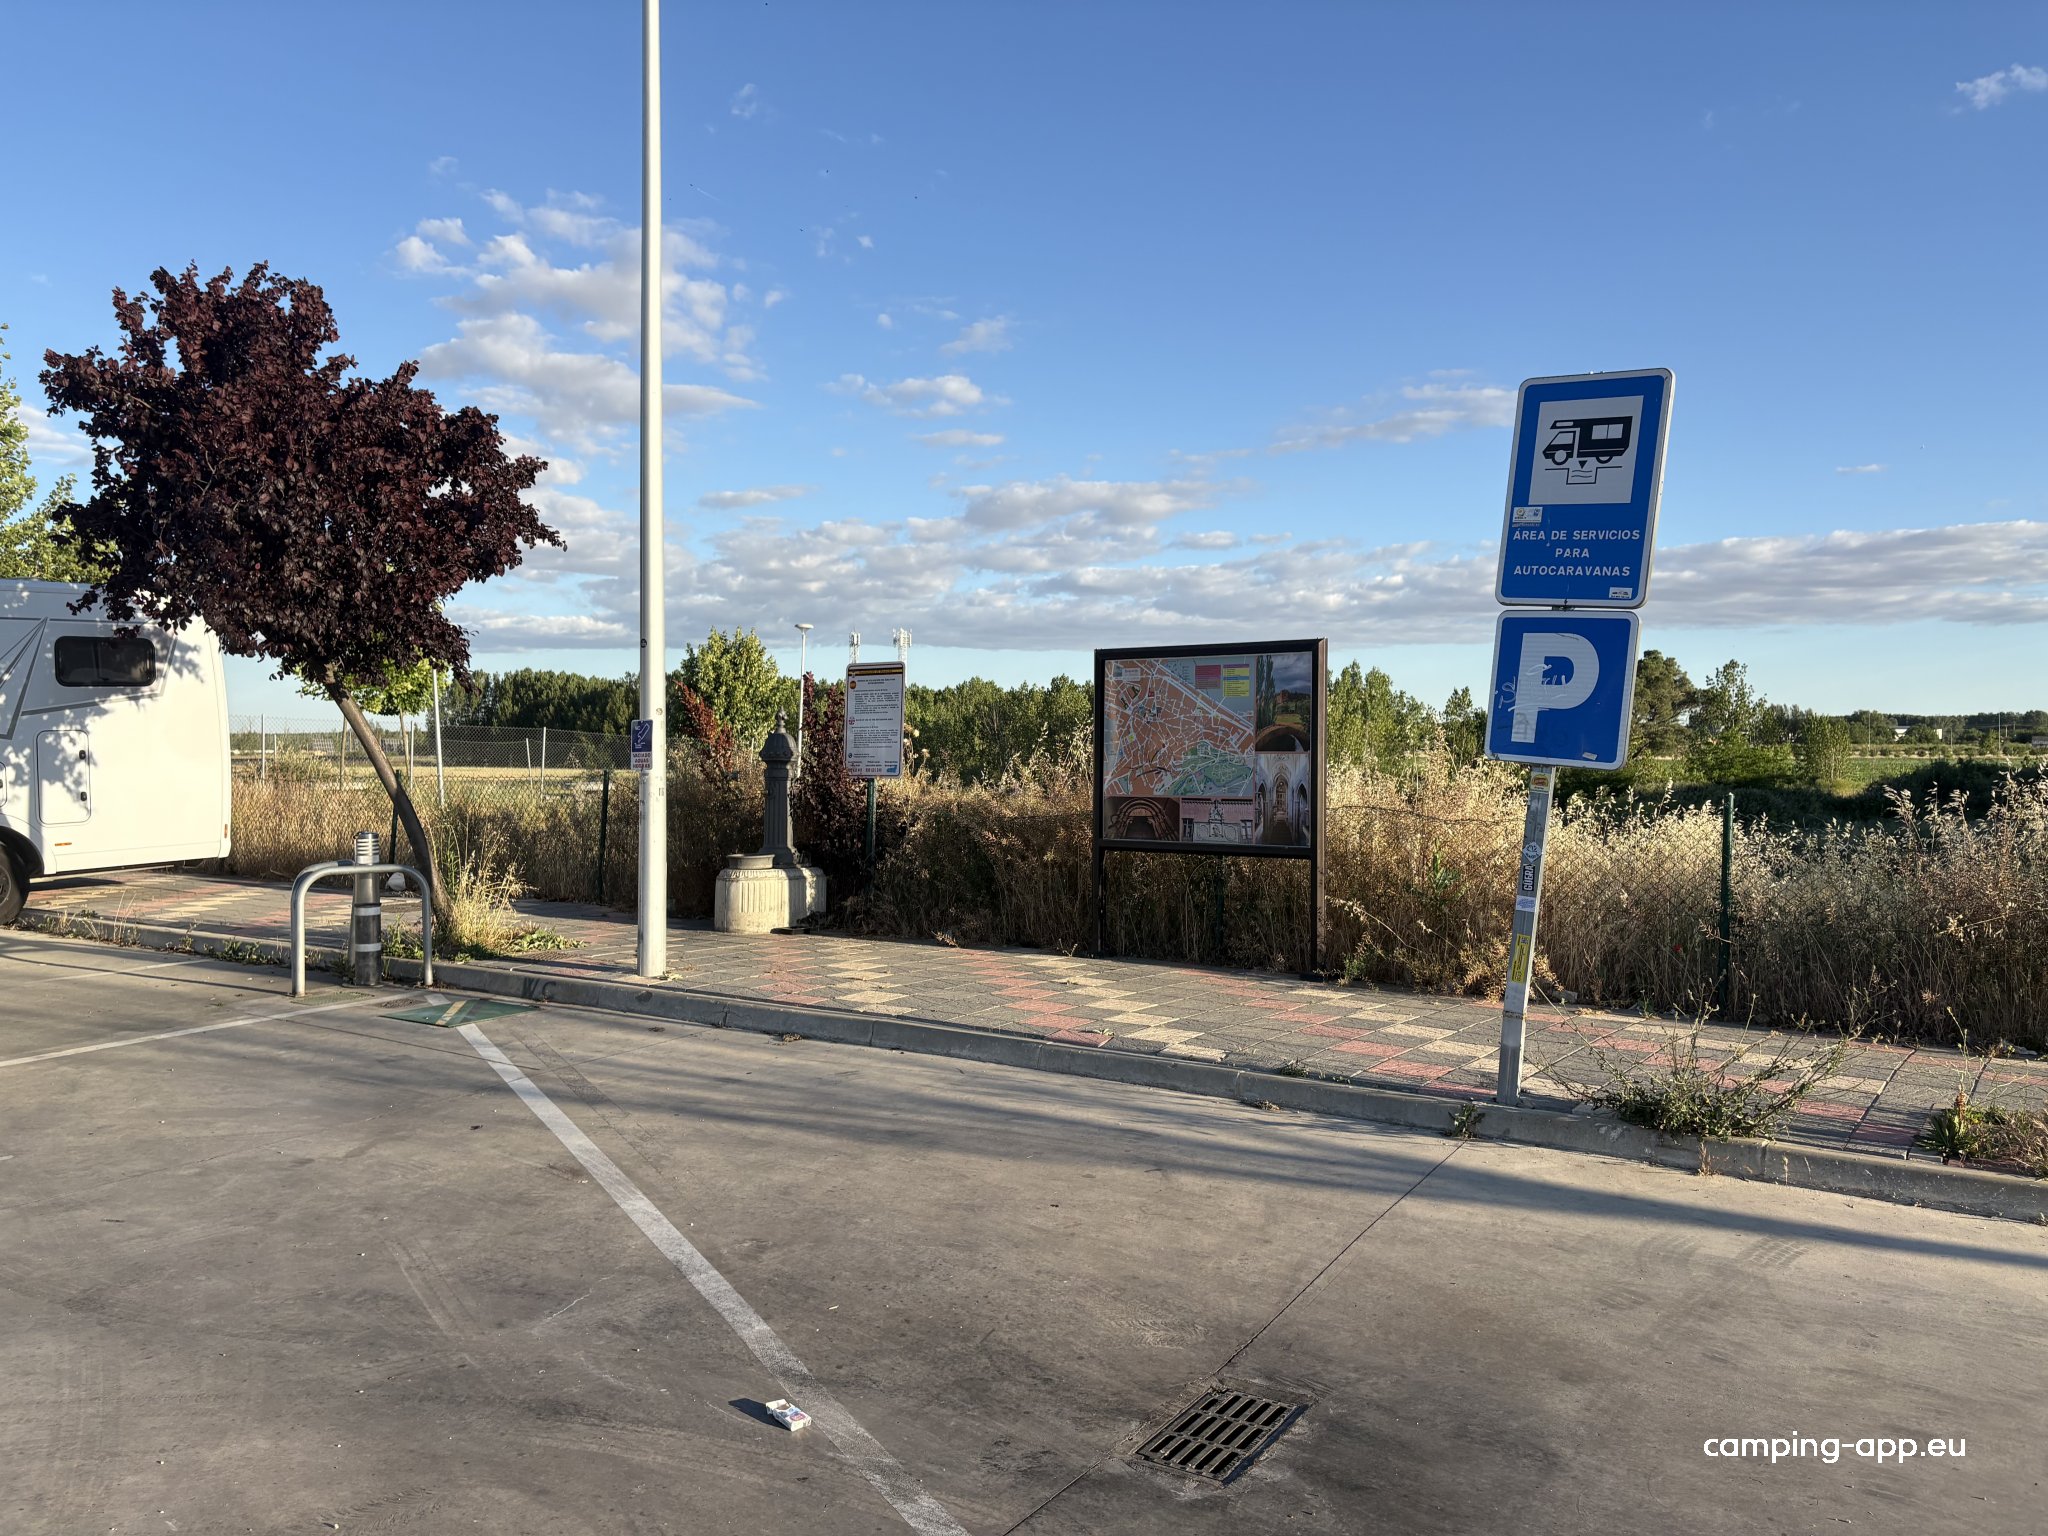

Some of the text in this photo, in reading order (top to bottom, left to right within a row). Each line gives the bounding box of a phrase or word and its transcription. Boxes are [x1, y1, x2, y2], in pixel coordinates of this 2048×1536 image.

[1513, 528, 1640, 540] ÁREA DE SERVICIOS
[1555, 548, 1589, 558] PARA
[1514, 565, 1630, 576] AUTOCARAVANAS
[1511, 632, 1600, 743] P
